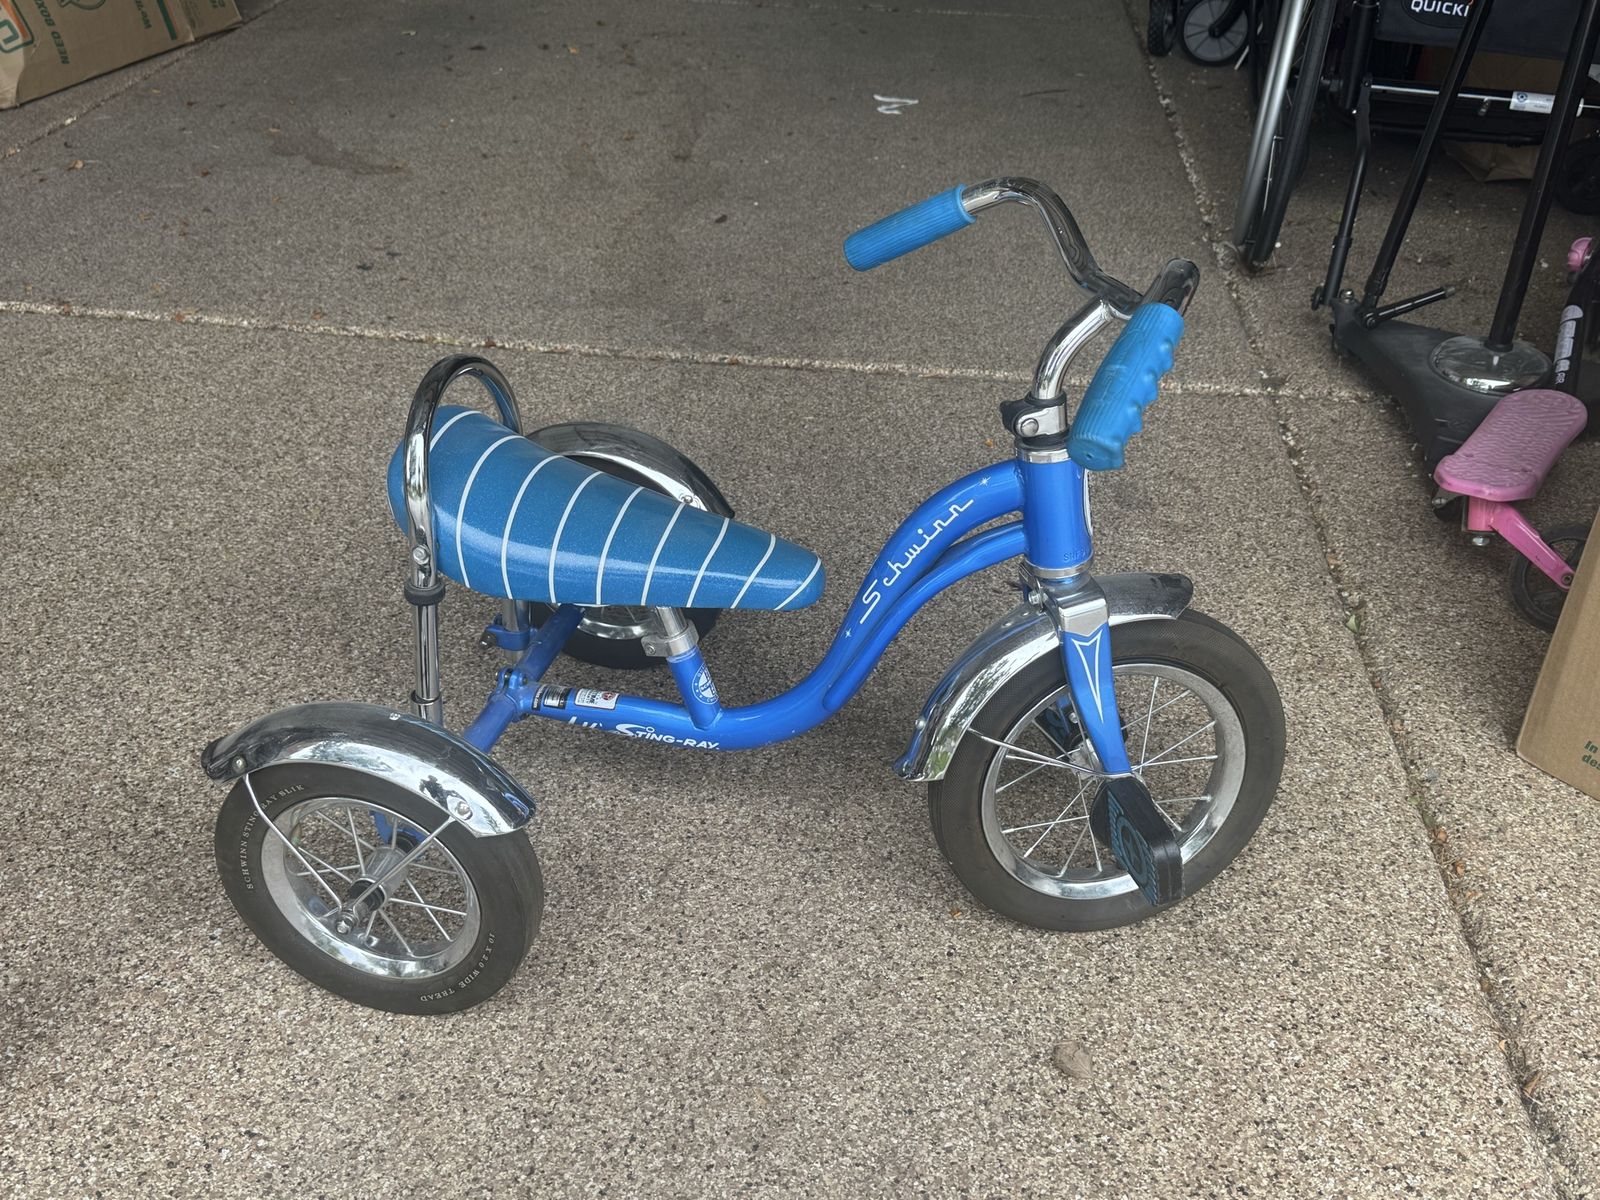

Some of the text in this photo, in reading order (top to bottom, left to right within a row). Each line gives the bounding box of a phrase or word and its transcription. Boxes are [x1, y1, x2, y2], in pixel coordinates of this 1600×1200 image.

[1410, 0, 1470, 17] QUICKI
[35, 0, 70, 65] NEED BOX
[859, 498, 975, 625] Schwinn
[1584, 740, 1598, 753] In
[240, 840, 255, 890] SCHWINN
[260, 795, 279, 810] RAY
[279, 784, 305, 798] SLIK
[488, 933, 495, 944] 10
[458, 969, 480, 988] WIDE
[420, 988, 456, 1002] TREAD
